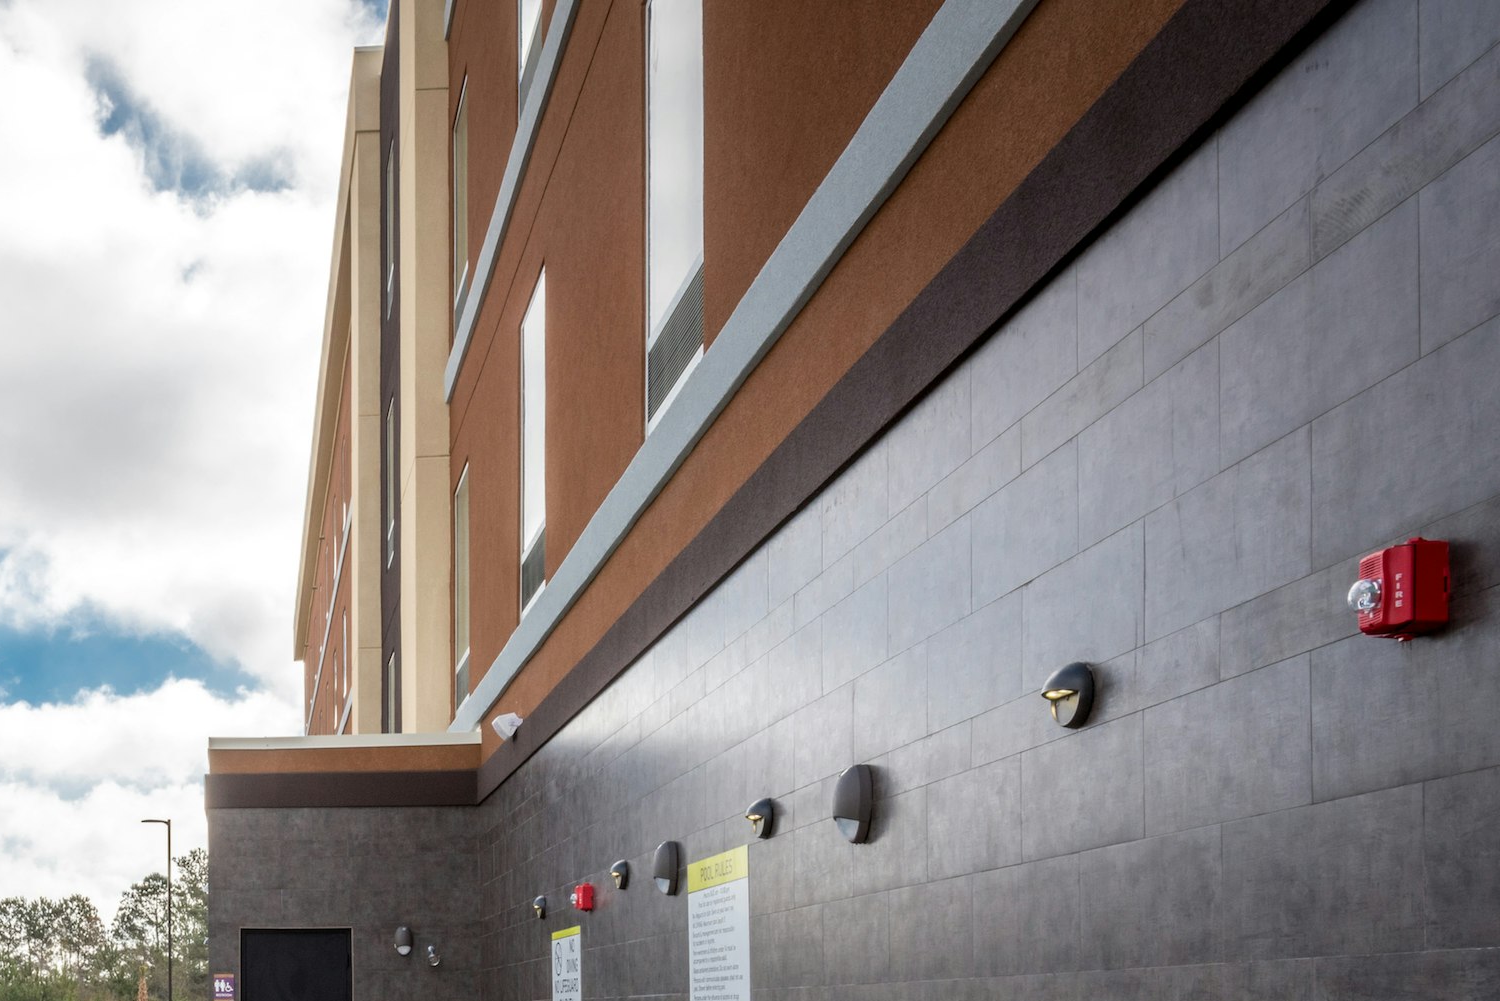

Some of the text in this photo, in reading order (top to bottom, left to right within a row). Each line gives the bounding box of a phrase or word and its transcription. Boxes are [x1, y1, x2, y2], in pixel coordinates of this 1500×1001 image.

[1395, 573, 1404, 608] FIRE
[700, 858, 732, 882] POOL RULES
